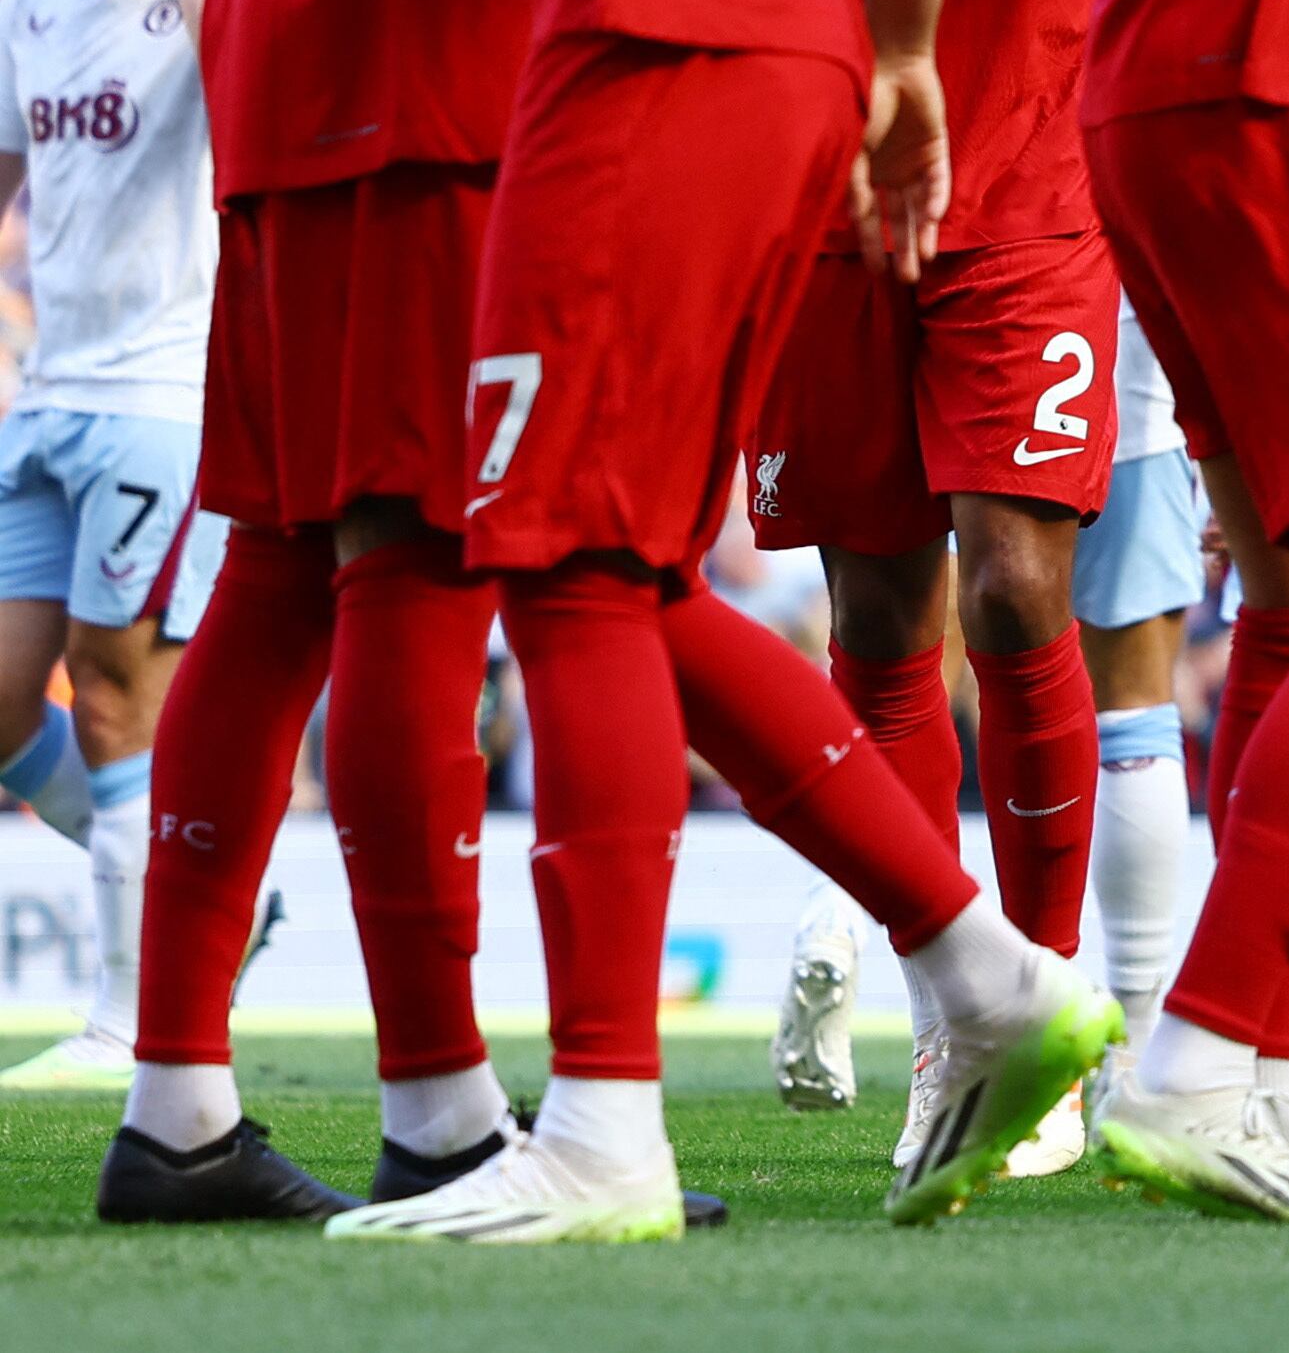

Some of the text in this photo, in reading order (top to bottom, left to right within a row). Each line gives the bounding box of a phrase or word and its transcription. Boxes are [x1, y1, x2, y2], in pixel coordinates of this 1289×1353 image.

[30, 91, 125, 143] BK8
[465, 352, 542, 483] 7
[1033, 331, 1095, 441] 2
[116, 482, 161, 553] 7
[149, 811, 216, 851] FC
